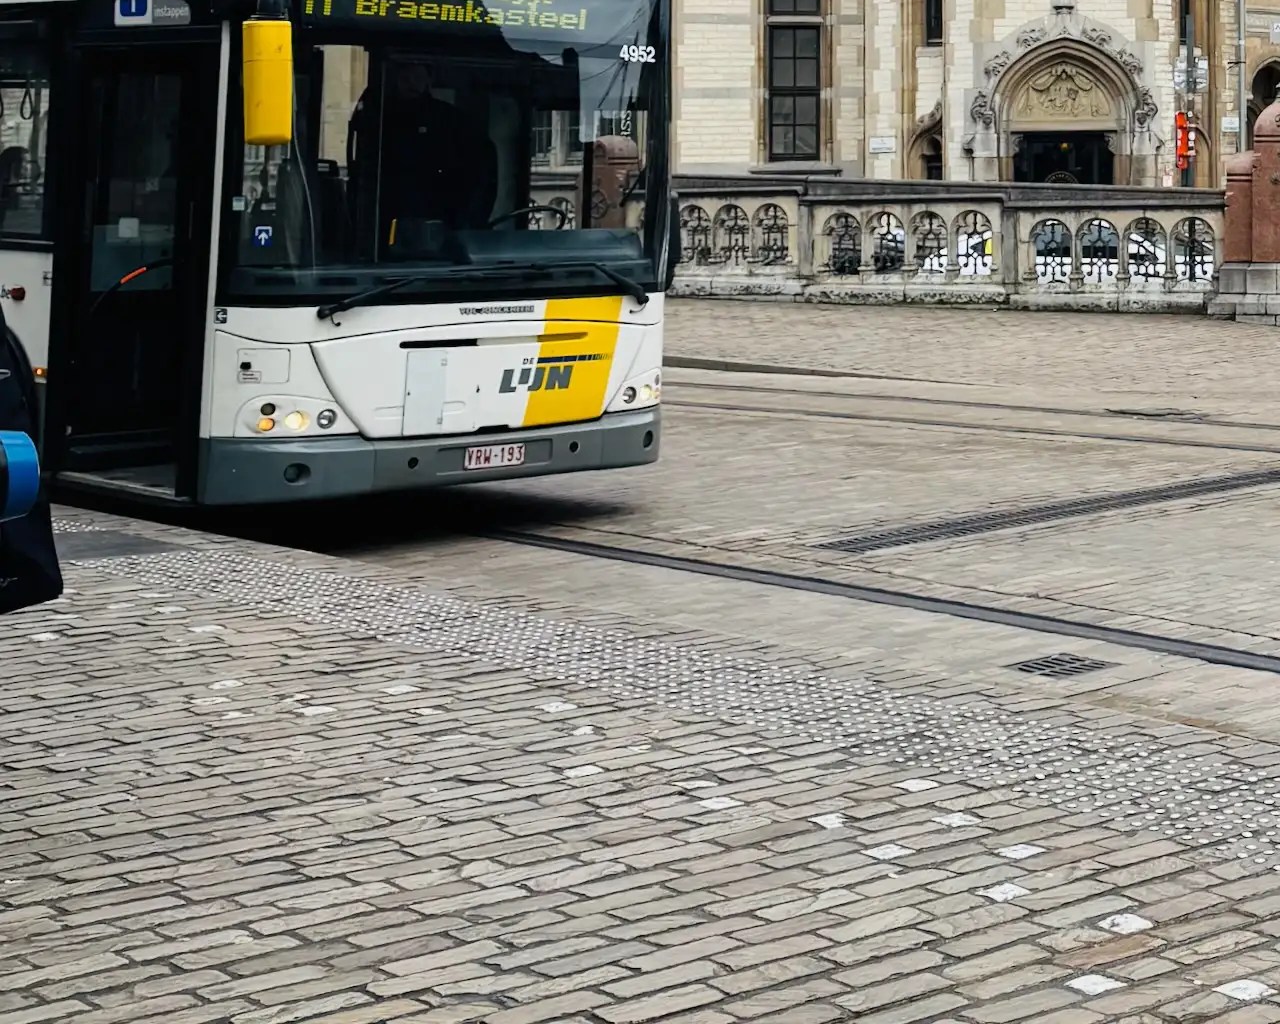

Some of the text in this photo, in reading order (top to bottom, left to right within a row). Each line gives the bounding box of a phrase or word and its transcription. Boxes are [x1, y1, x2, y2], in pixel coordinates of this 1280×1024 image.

[618, 44, 657, 63] 4952
[522, 357, 536, 365] DE
[499, 365, 574, 394] LIJN
[466, 446, 524, 466] VRW-193
